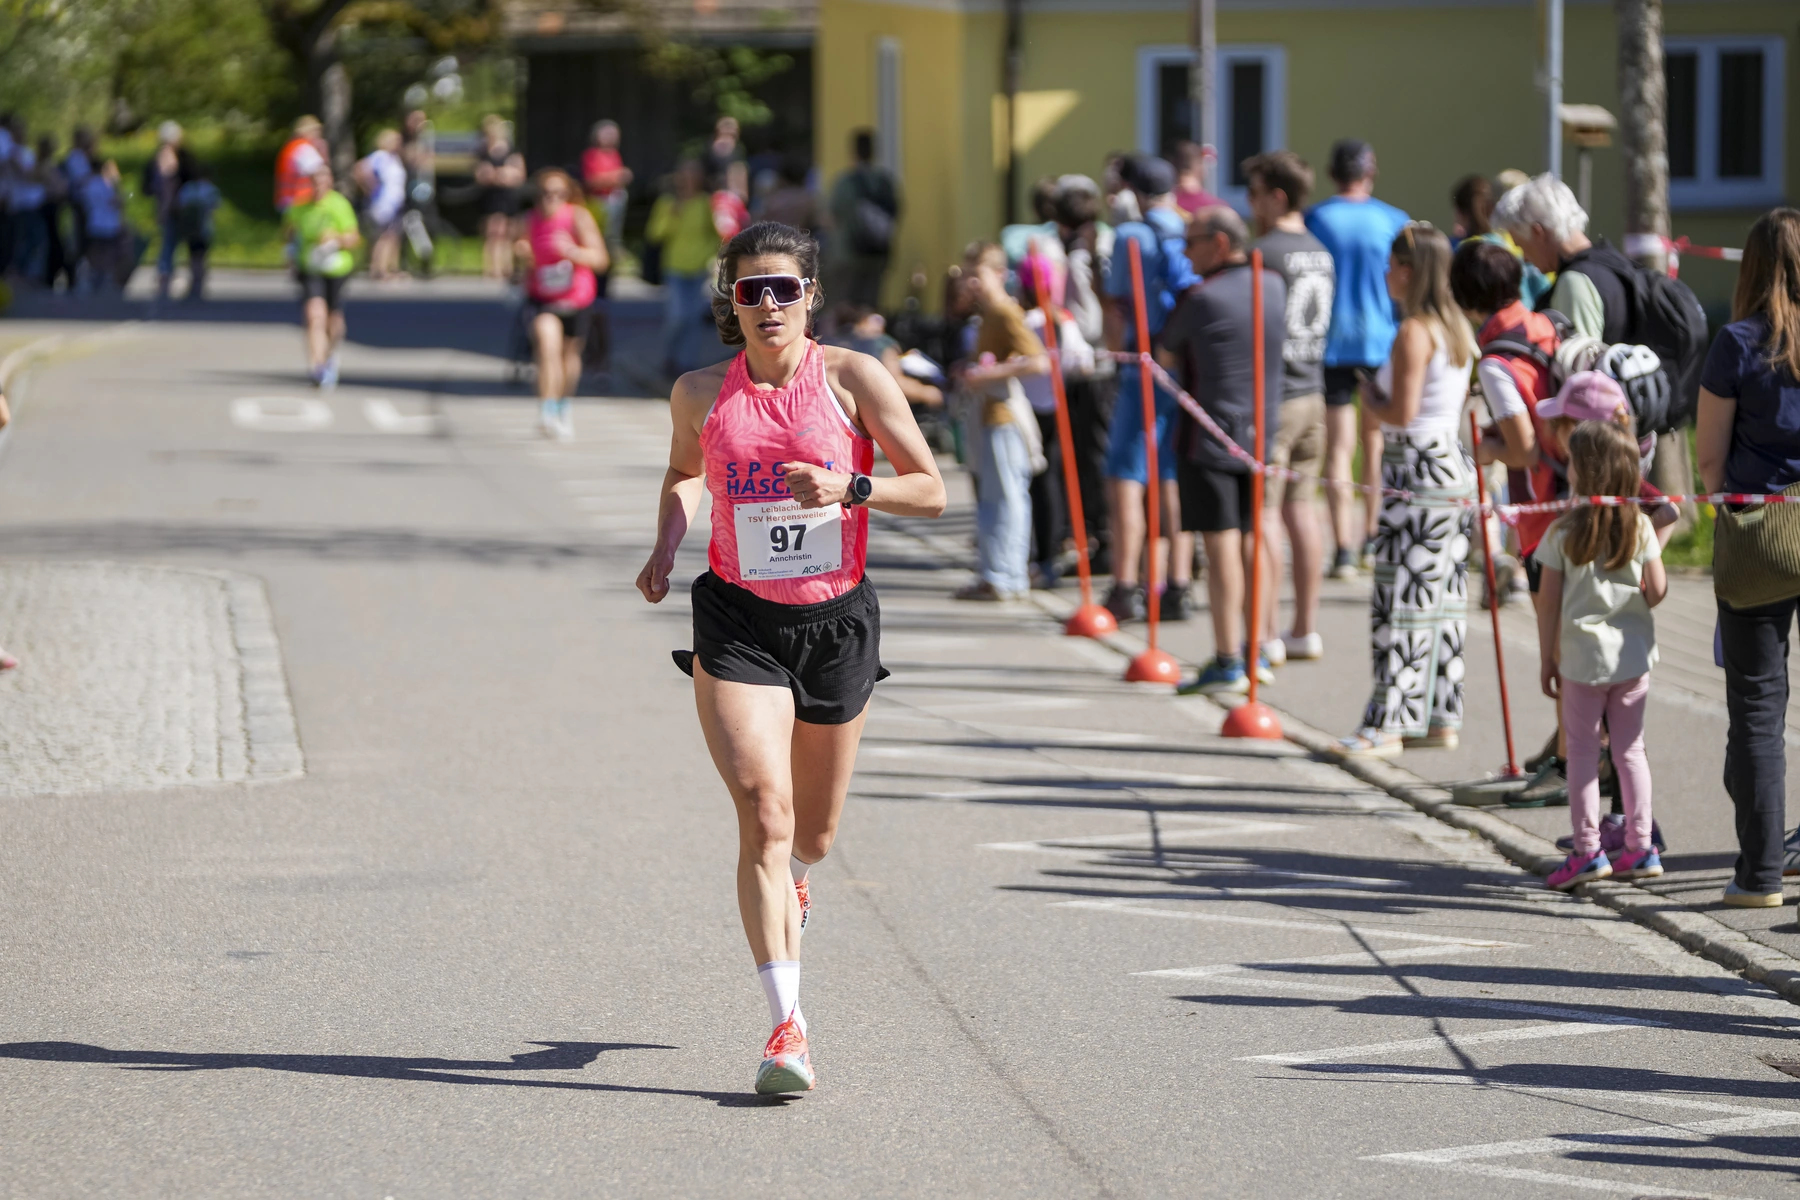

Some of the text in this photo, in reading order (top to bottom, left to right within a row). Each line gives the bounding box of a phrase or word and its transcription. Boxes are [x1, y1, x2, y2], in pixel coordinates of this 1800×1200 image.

[726, 461, 835, 478] SPOT
[727, 478, 791, 495] HASC
[766, 511, 828, 523] Hergensweiler
[770, 524, 807, 553] 97
[769, 553, 812, 563] Annchristin
[802, 564, 822, 575] AOK
